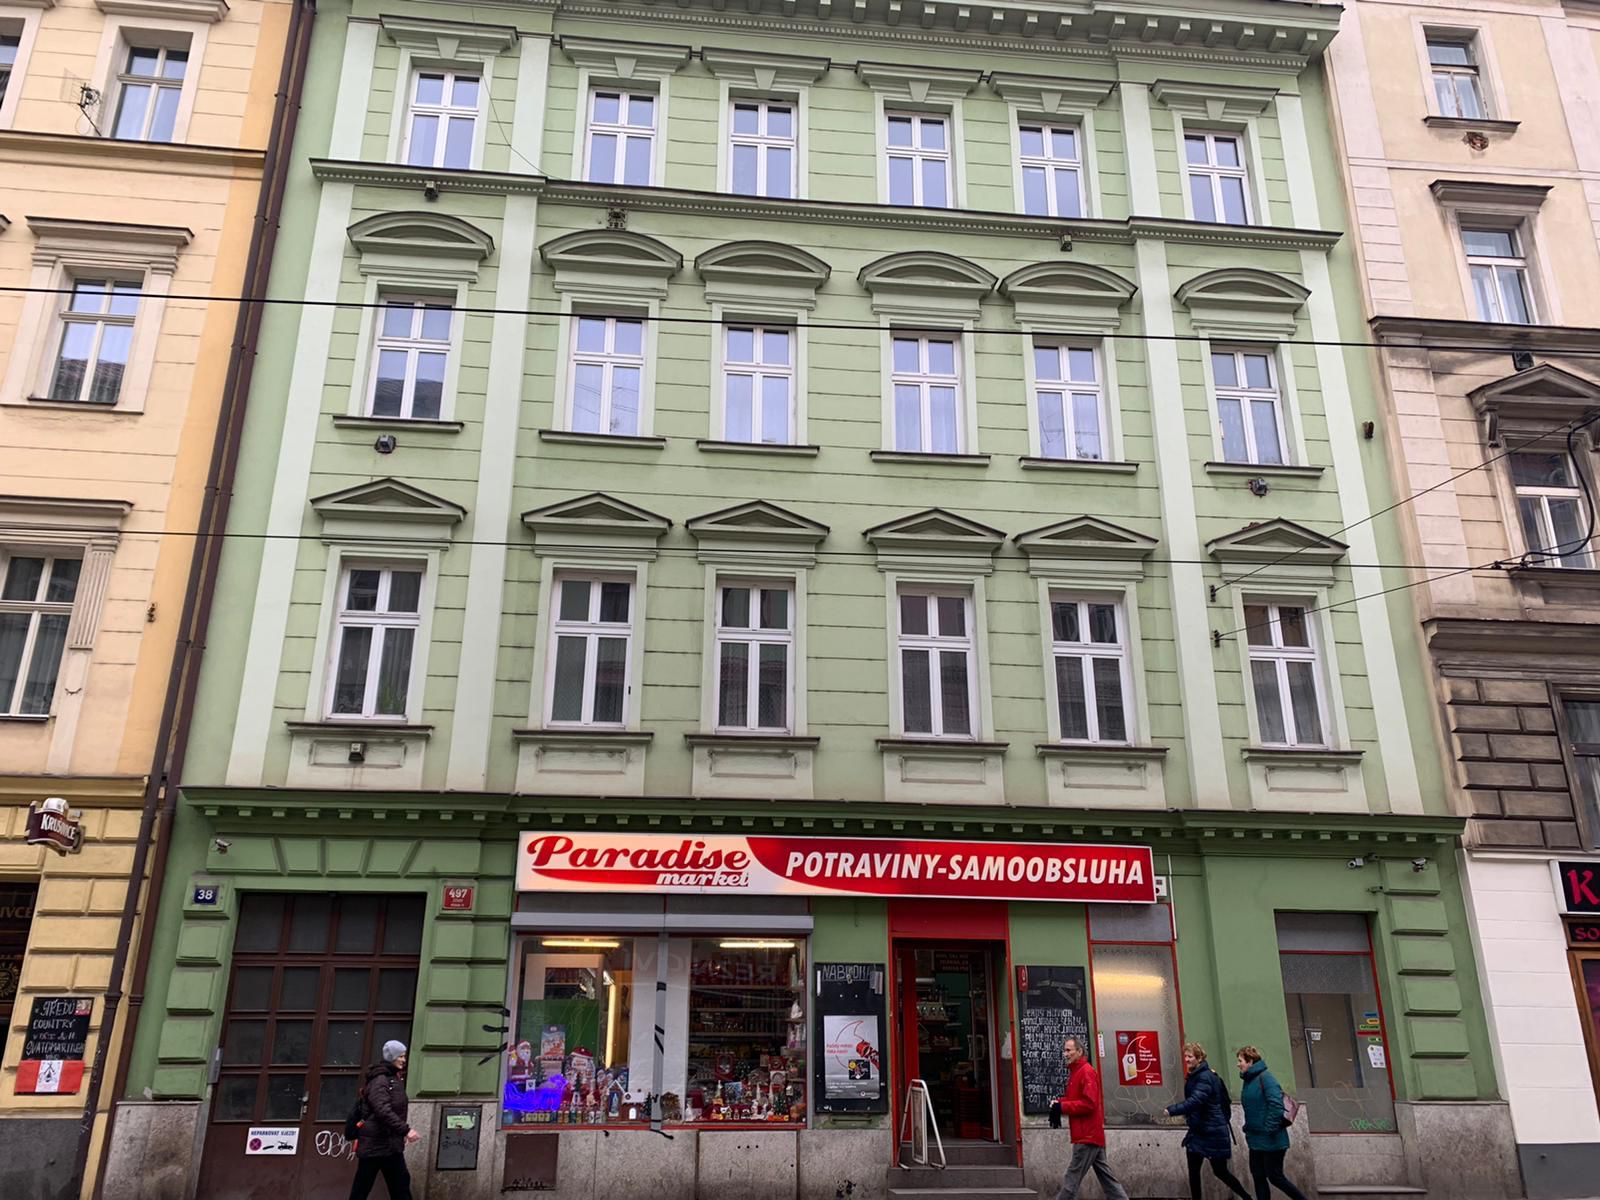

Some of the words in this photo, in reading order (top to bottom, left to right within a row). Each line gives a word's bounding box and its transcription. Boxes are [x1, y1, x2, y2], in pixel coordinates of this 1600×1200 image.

[527, 835, 750, 870] Paradise
[785, 851, 1144, 885] POTRAVINY-SAMOOBSLUHA
[656, 870, 749, 887] market
[198, 889, 213, 900] 38
[448, 888, 468, 898] 497
[1575, 927, 1600, 940] SO
